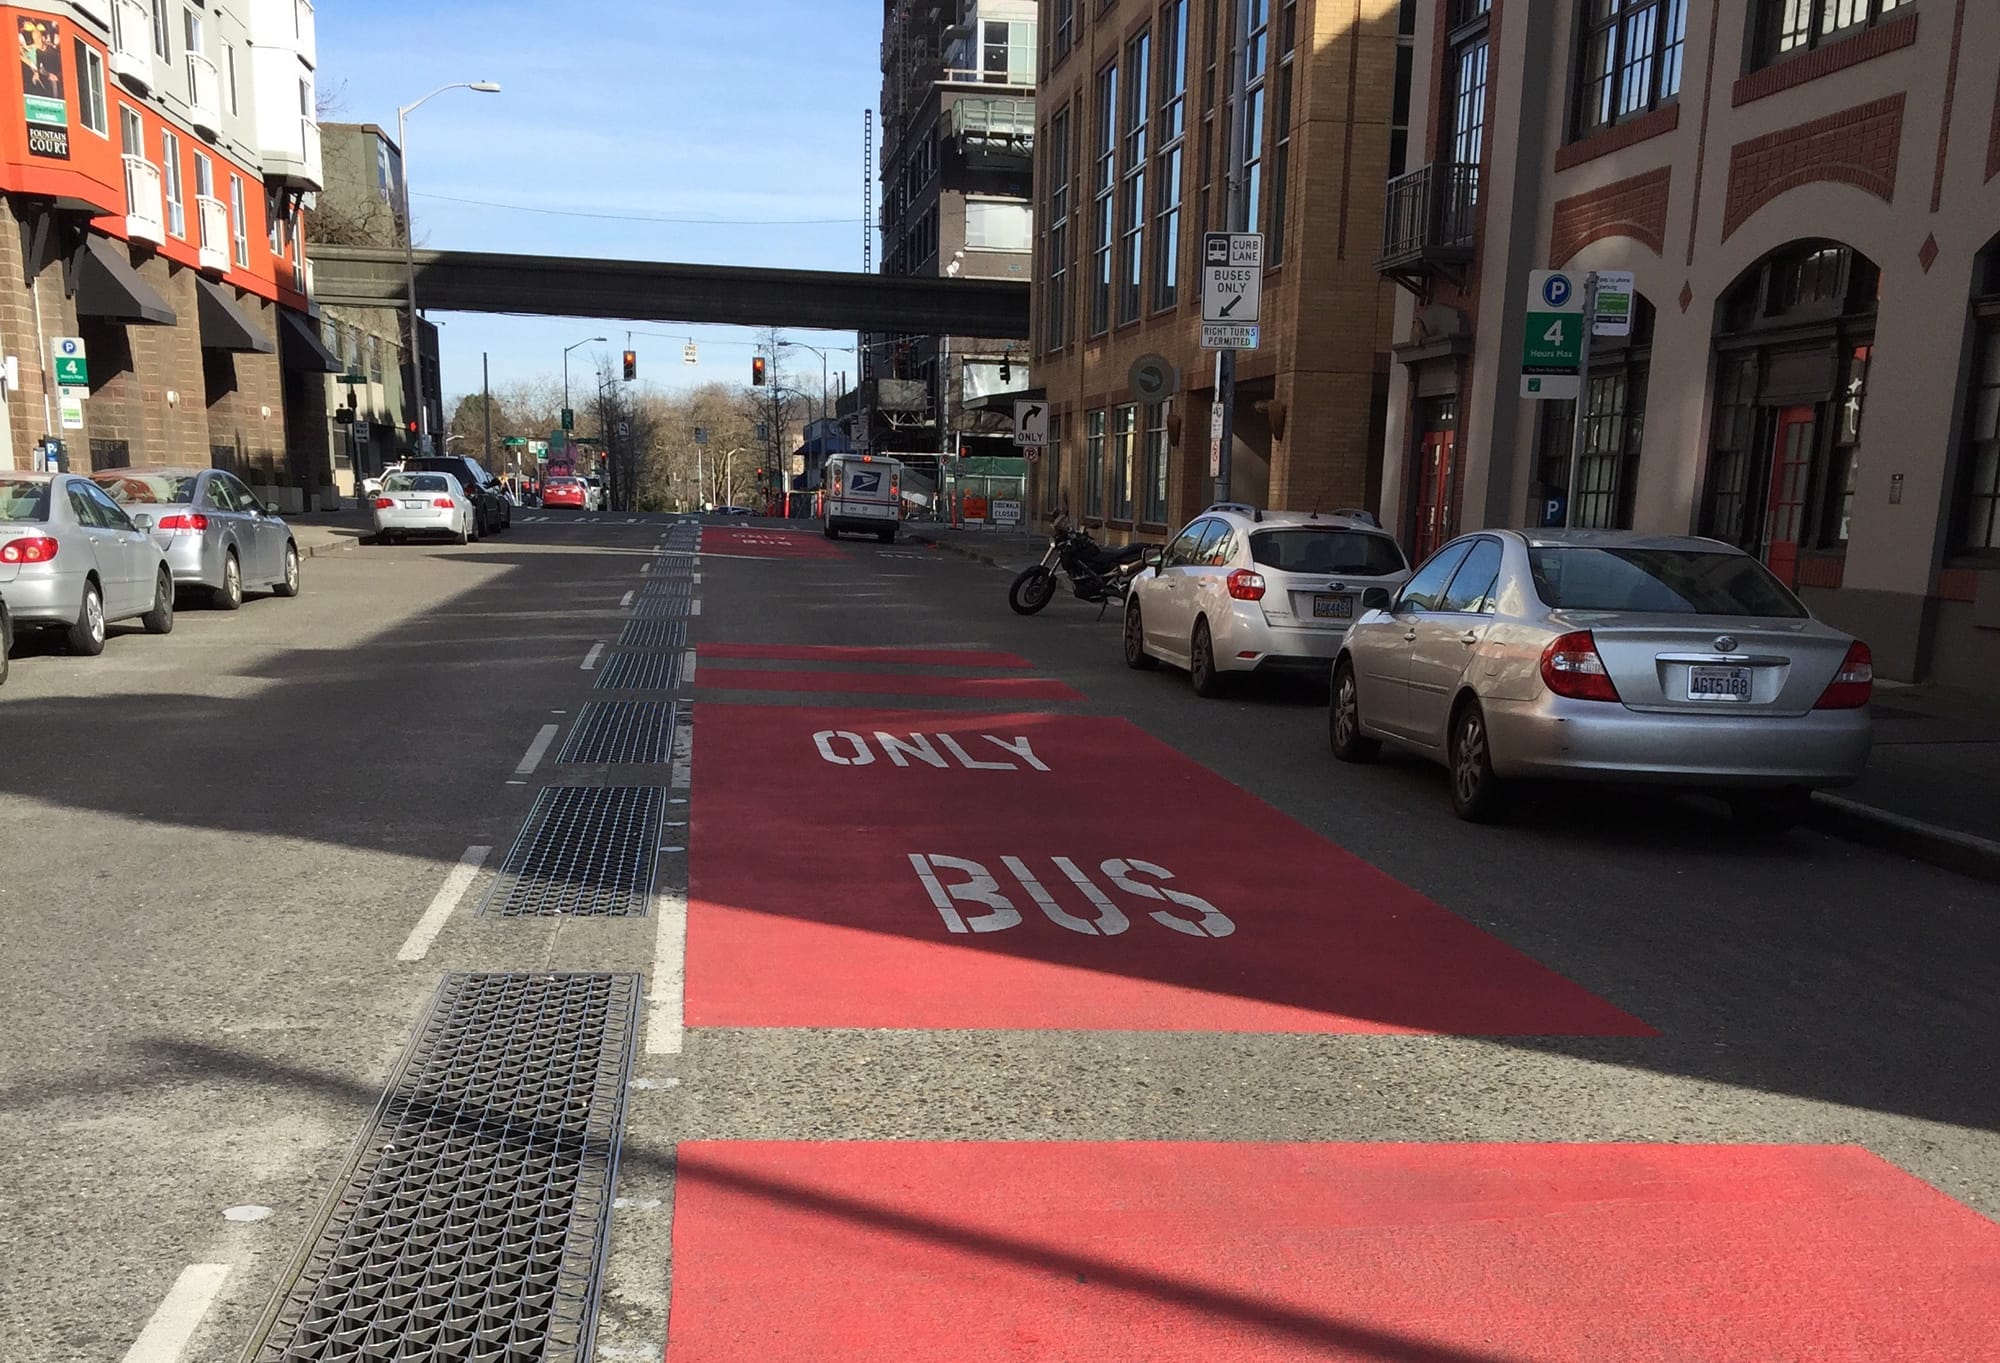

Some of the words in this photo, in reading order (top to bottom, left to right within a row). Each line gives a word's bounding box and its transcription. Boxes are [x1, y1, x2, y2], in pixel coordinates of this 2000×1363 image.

[29, 128, 67, 140] FOUNTAIN
[29, 138, 68, 155] COURT
[1232, 240, 1259, 250] CURB
[1232, 252, 1258, 261] LANE
[1214, 270, 1251, 281] BUSES
[1217, 282, 1247, 293] ONLY
[1551, 281, 1566, 300] P
[1204, 326, 1228, 337] RIGHT
[1230, 327, 1256, 337] TURNS
[1543, 319, 1564, 346] 4
[65, 342, 74, 352] P
[1208, 337, 1251, 346] PERMITTED
[1530, 350, 1555, 358] Hours
[1556, 350, 1573, 358] Max
[65, 360, 78, 374] 4
[1018, 432, 1043, 441] ONLY
[994, 510, 1019, 518] CLOSED
[1546, 500, 1559, 520] P
[1693, 677, 1748, 695] AGT5188
[812, 730, 1052, 772] ONLY
[907, 853, 1237, 938] BUS
